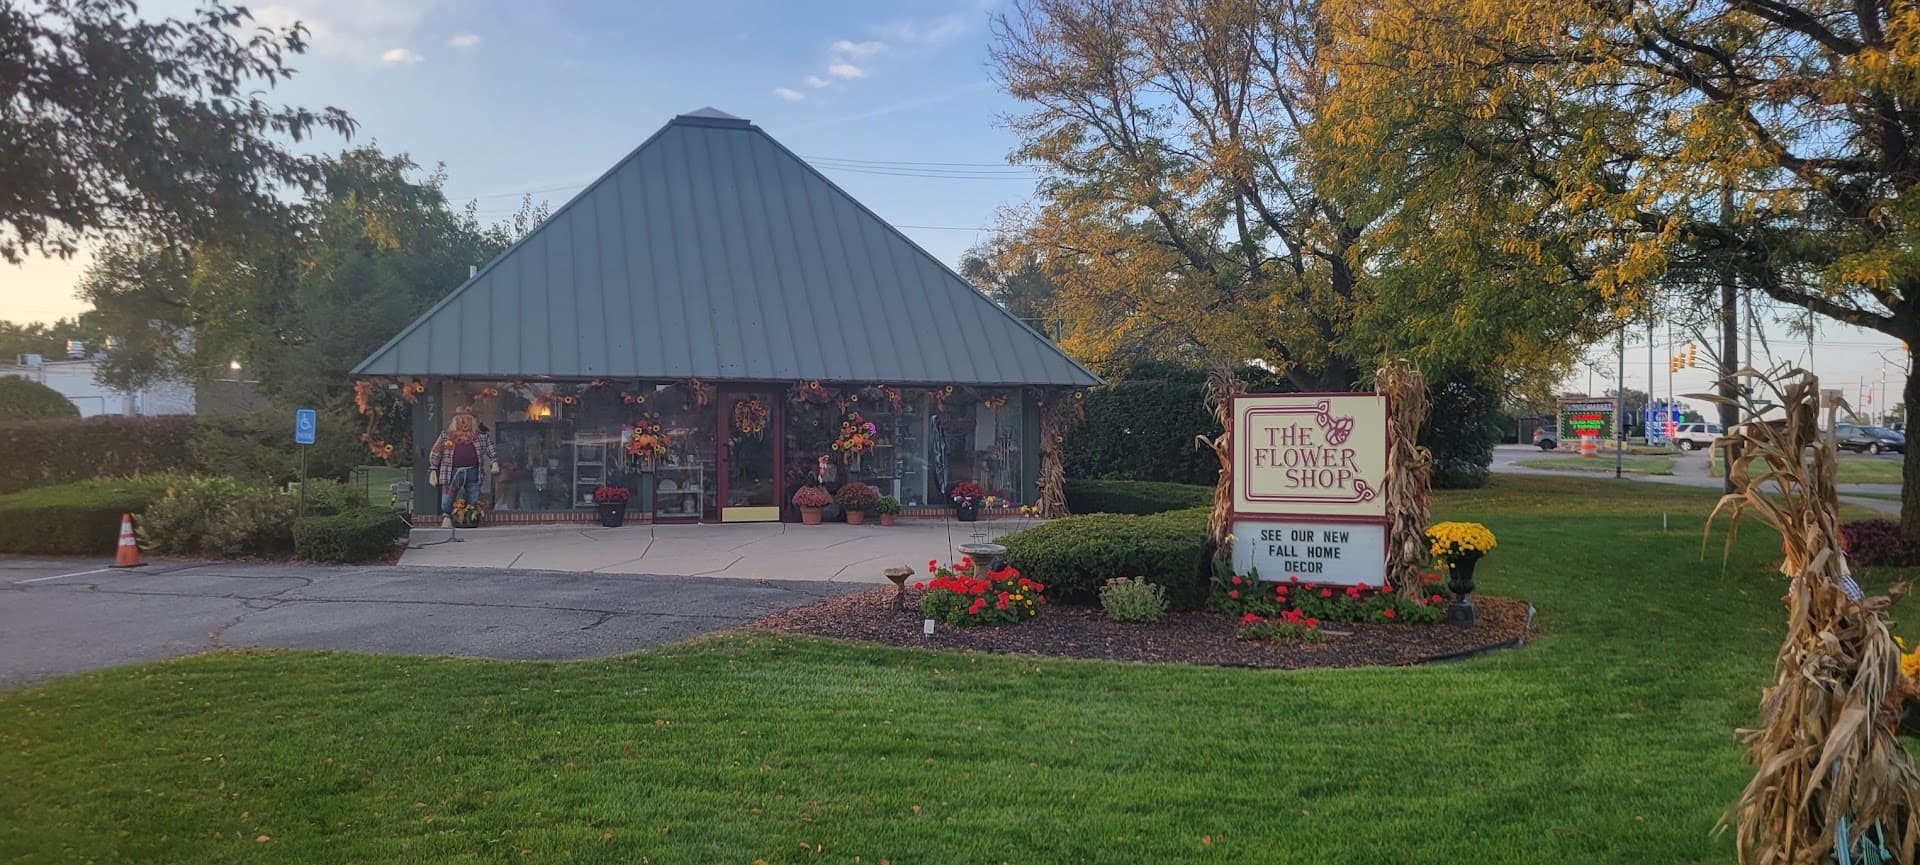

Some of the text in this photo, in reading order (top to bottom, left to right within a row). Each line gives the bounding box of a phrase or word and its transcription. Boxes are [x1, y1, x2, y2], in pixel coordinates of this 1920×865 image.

[1264, 423, 1313, 447] THE
[1255, 445, 1362, 473] FLOWER
[1284, 469, 1353, 489] SHOP
[1260, 529, 1349, 544] SEE OUR NEW
[1269, 545, 1341, 559] FALL HOME
[1284, 561, 1323, 573] DECOR
